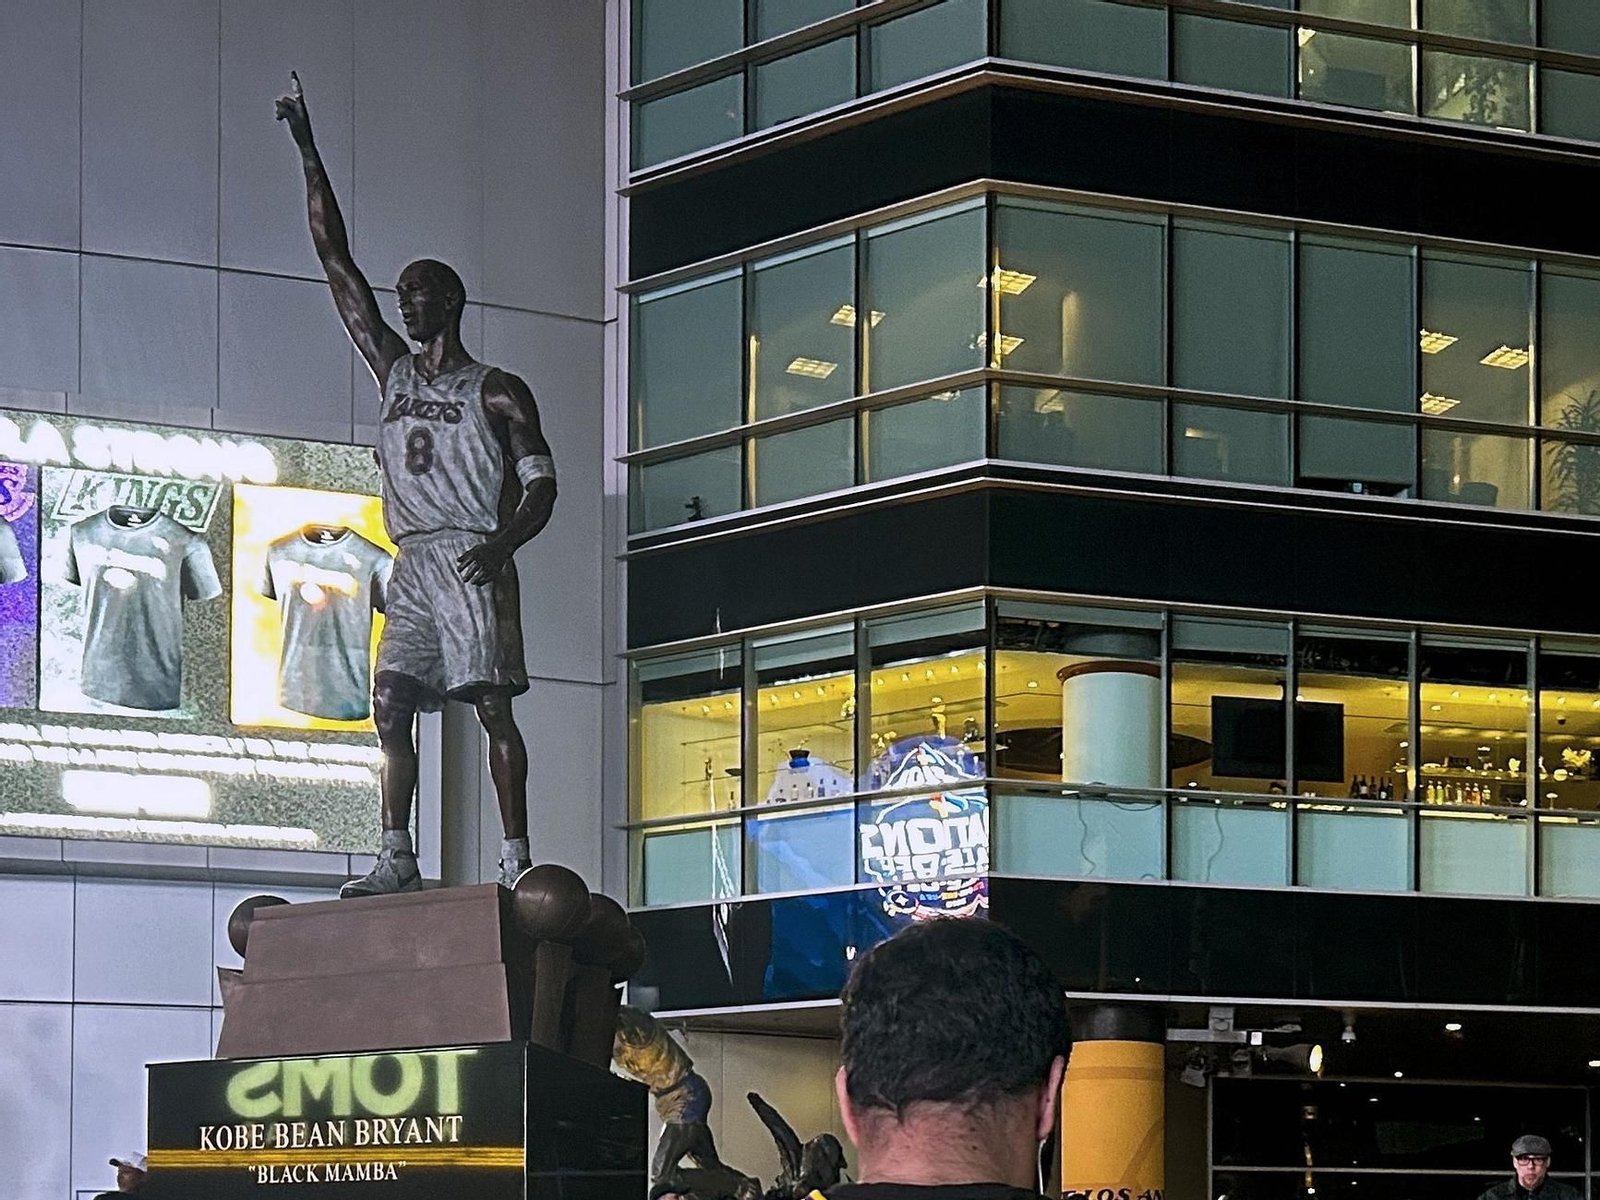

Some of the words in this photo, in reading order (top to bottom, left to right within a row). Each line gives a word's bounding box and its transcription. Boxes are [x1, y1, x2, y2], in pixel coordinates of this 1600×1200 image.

[383, 393, 466, 424] LAKERS
[404, 426, 434, 476] 8
[69, 474, 210, 523] KINGS
[200, 1123, 266, 1151] KOBE
[274, 1120, 346, 1149] BEAN
[354, 1115, 463, 1147] BRYANT
